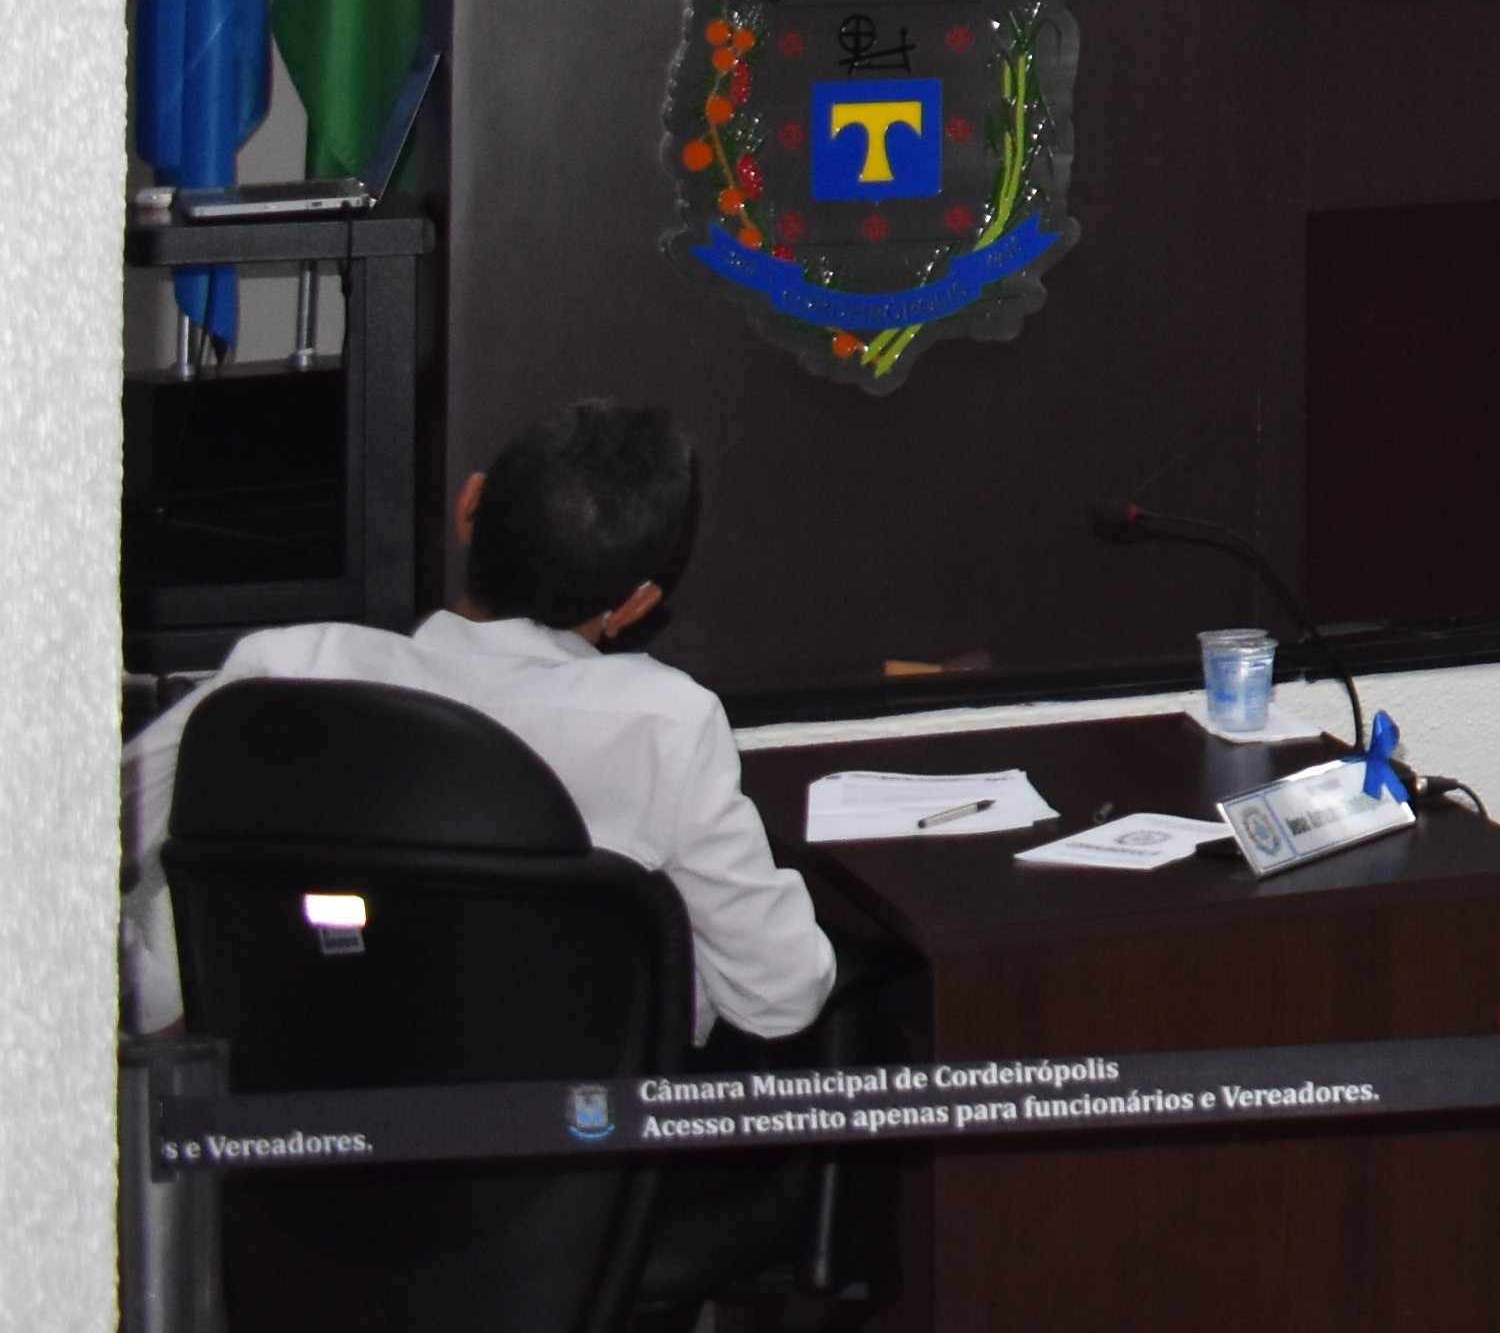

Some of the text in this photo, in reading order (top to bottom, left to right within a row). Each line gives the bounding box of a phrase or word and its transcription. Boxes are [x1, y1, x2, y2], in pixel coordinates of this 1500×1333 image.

[640, 1056, 1120, 1103] Câmara Municipal de Cordeirópolis
[642, 1080, 1380, 1139] Acesso restrito apenas para funcionários e Vereadores.
[184, 1139, 202, 1159] e
[205, 1129, 375, 1161] Vereadores.
